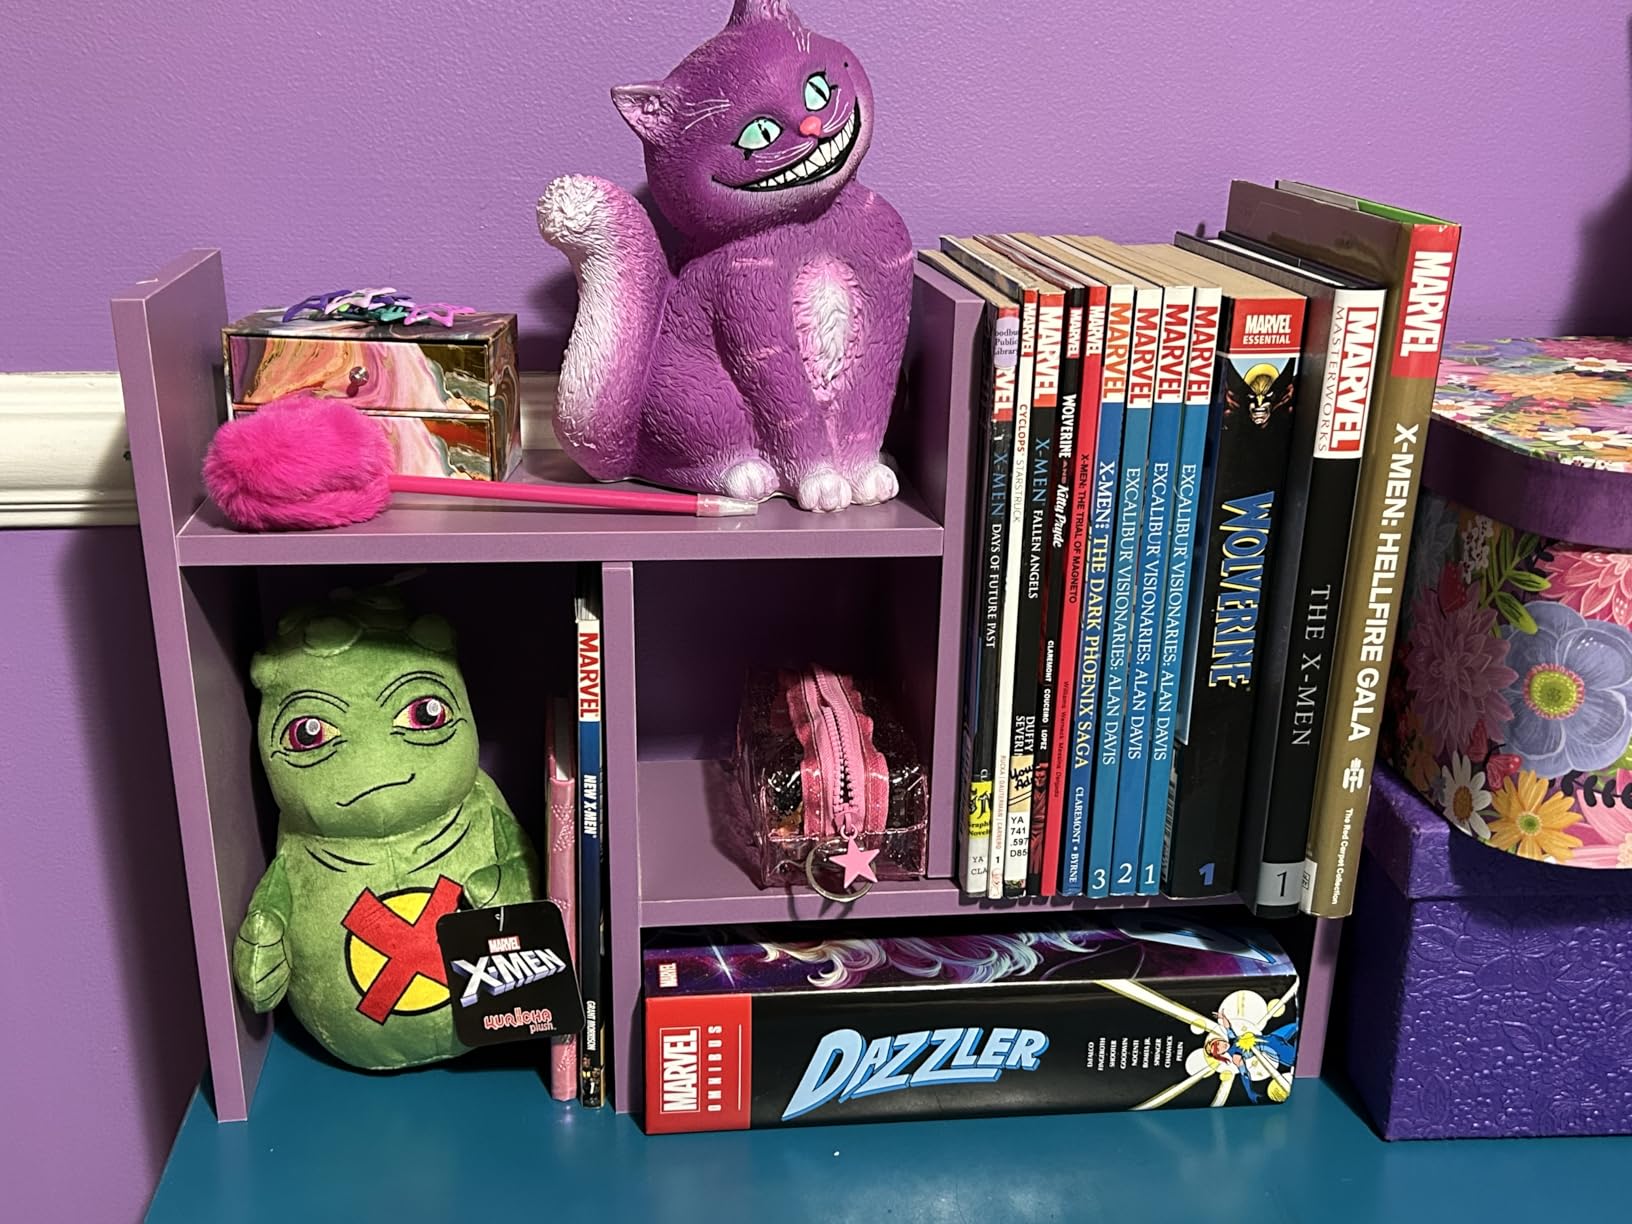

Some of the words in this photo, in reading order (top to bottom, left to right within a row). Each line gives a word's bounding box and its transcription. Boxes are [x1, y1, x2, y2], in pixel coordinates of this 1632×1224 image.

[1245, 314, 1292, 334] MARVEL
[1400, 251, 1453, 357] MARVEL
[1021, 303, 1036, 355] MARVEL
[1067, 308, 1083, 358] MARVEL
[1086, 305, 1105, 357] MARVEL
[1103, 302, 1133, 399] MARVEL
[1155, 303, 1190, 400] MARVEL
[1243, 335, 1291, 345] ESSENTIAL
[1036, 306, 1063, 400] MARVEL
[1130, 307, 1160, 404] MARVEL
[1187, 305, 1219, 401] MARVEL
[1318, 305, 1346, 453] MASTERWORKS
[1330, 310, 1378, 449] MARVEL
[1015, 404, 1028, 453] CYCLOPS
[1058, 394, 1077, 458] WOLVERINE
[991, 452, 1009, 516] X-MEN
[1012, 460, 1025, 522] STARSTRUCK
[1032, 439, 1050, 502] X-MEN
[1078, 454, 1090, 488] X-MEN:
[1382, 423, 1420, 527] X-MEN:
[1056, 485, 1069, 515] Kitty
[1077, 491, 1087, 509] THE
[1095, 461, 1116, 529] X-MEN:
[1119, 467, 1141, 561] EXCALIBUR
[1146, 462, 1169, 556] EXCALIBUR
[1174, 464, 1197, 558] EXCALIBUR
[991, 524, 1002, 553] DAYS
[1031, 509, 1043, 551] FALLEN
[1052, 513, 1066, 548] Pryde
[1073, 541, 1081, 553] OF
[1074, 512, 1085, 539] TRIAL
[989, 556, 1000, 572] OF
[1091, 534, 1109, 573] THE
[987, 575, 999, 620] FUTURE
[1028, 554, 1041, 599] ANGELS
[1069, 555, 1081, 604] MAGNETO
[1208, 491, 1275, 688] WOLVERINE
[1360, 533, 1402, 662] HELLFIRE
[1086, 579, 1105, 633] DARK
[1109, 565, 1131, 671] VISIONARIES:
[1136, 560, 1160, 665] VISIONARIES:
[1163, 561, 1187, 667] VISIONARIES:
[1304, 584, 1331, 641] THE
[985, 622, 997, 648] PAST
[579, 632, 599, 718] MARVEL
[1045, 640, 1055, 682] CLAREMONT
[1078, 635, 1100, 718] PHOENIX
[1041, 688, 1051, 723] COUCEIRO
[1106, 674, 1123, 716] ALAN
[1131, 668, 1149, 712] ALAN
[1155, 670, 1175, 713] ALAN
[1291, 653, 1322, 746] X-MEN
[1348, 667, 1380, 742] GALA
[1024, 716, 1035, 752] DUFFY
[1040, 729, 1048, 750] LOPEZ
[1074, 721, 1093, 769] SAGA
[1102, 719, 1120, 766] DAVIS
[1127, 716, 1145, 761] DAVIS
[1153, 717, 1171, 761] DAVIS
[584, 774, 597, 794] NEW
[1010, 826, 1026, 835] 741
[1011, 816, 1024, 825] YA
[1071, 786, 1084, 844] CLAREMONT
[1341, 824, 1351, 840] Red
[1343, 808, 1354, 824] The
[995, 856, 1000, 864] 1
[1068, 852, 1080, 883] BYRNE
[1118, 863, 1133, 885] 2
[1144, 864, 1156, 884] 1
[1198, 862, 1215, 886] 1
[1336, 840, 1348, 867] Carpet
[1092, 868, 1106, 889] 3
[1276, 871, 1288, 897] 1
[1331, 867, 1344, 905] Collection
[488, 936, 521, 953] MARVEL
[451, 948, 567, 1008] X-MEN
[586, 1000, 596, 1020] GRANT
[663, 1029, 698, 1112] MARVEL
[707, 1024, 723, 1112] OMNIBUS
[781, 1027, 1050, 1122] DAZZLER
[1120, 1037, 1128, 1070] GOODWIN
[589, 1081, 595, 1094] 1
